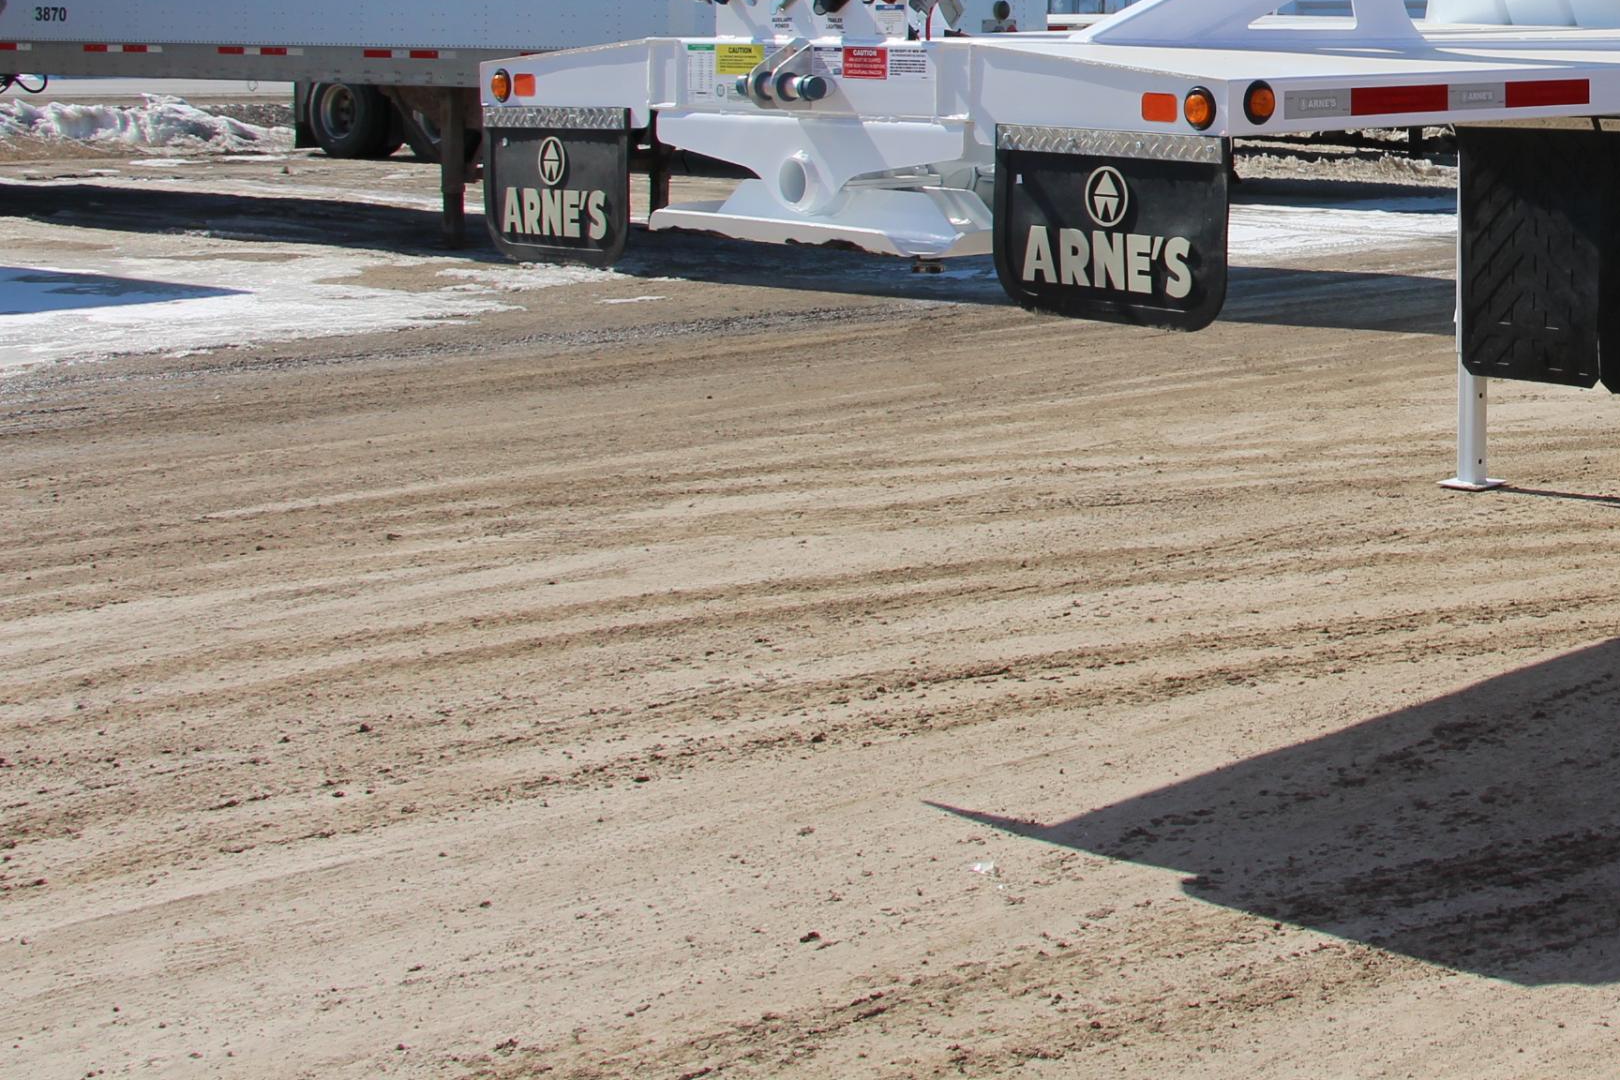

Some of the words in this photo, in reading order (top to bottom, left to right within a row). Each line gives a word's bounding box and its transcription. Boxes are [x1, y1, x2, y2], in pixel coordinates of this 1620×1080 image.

[34, 6, 67, 22] 3870
[852, 49, 877, 57] CAUTION
[503, 186, 607, 240] ARNE'S
[1022, 224, 1193, 299] ARNE'S
